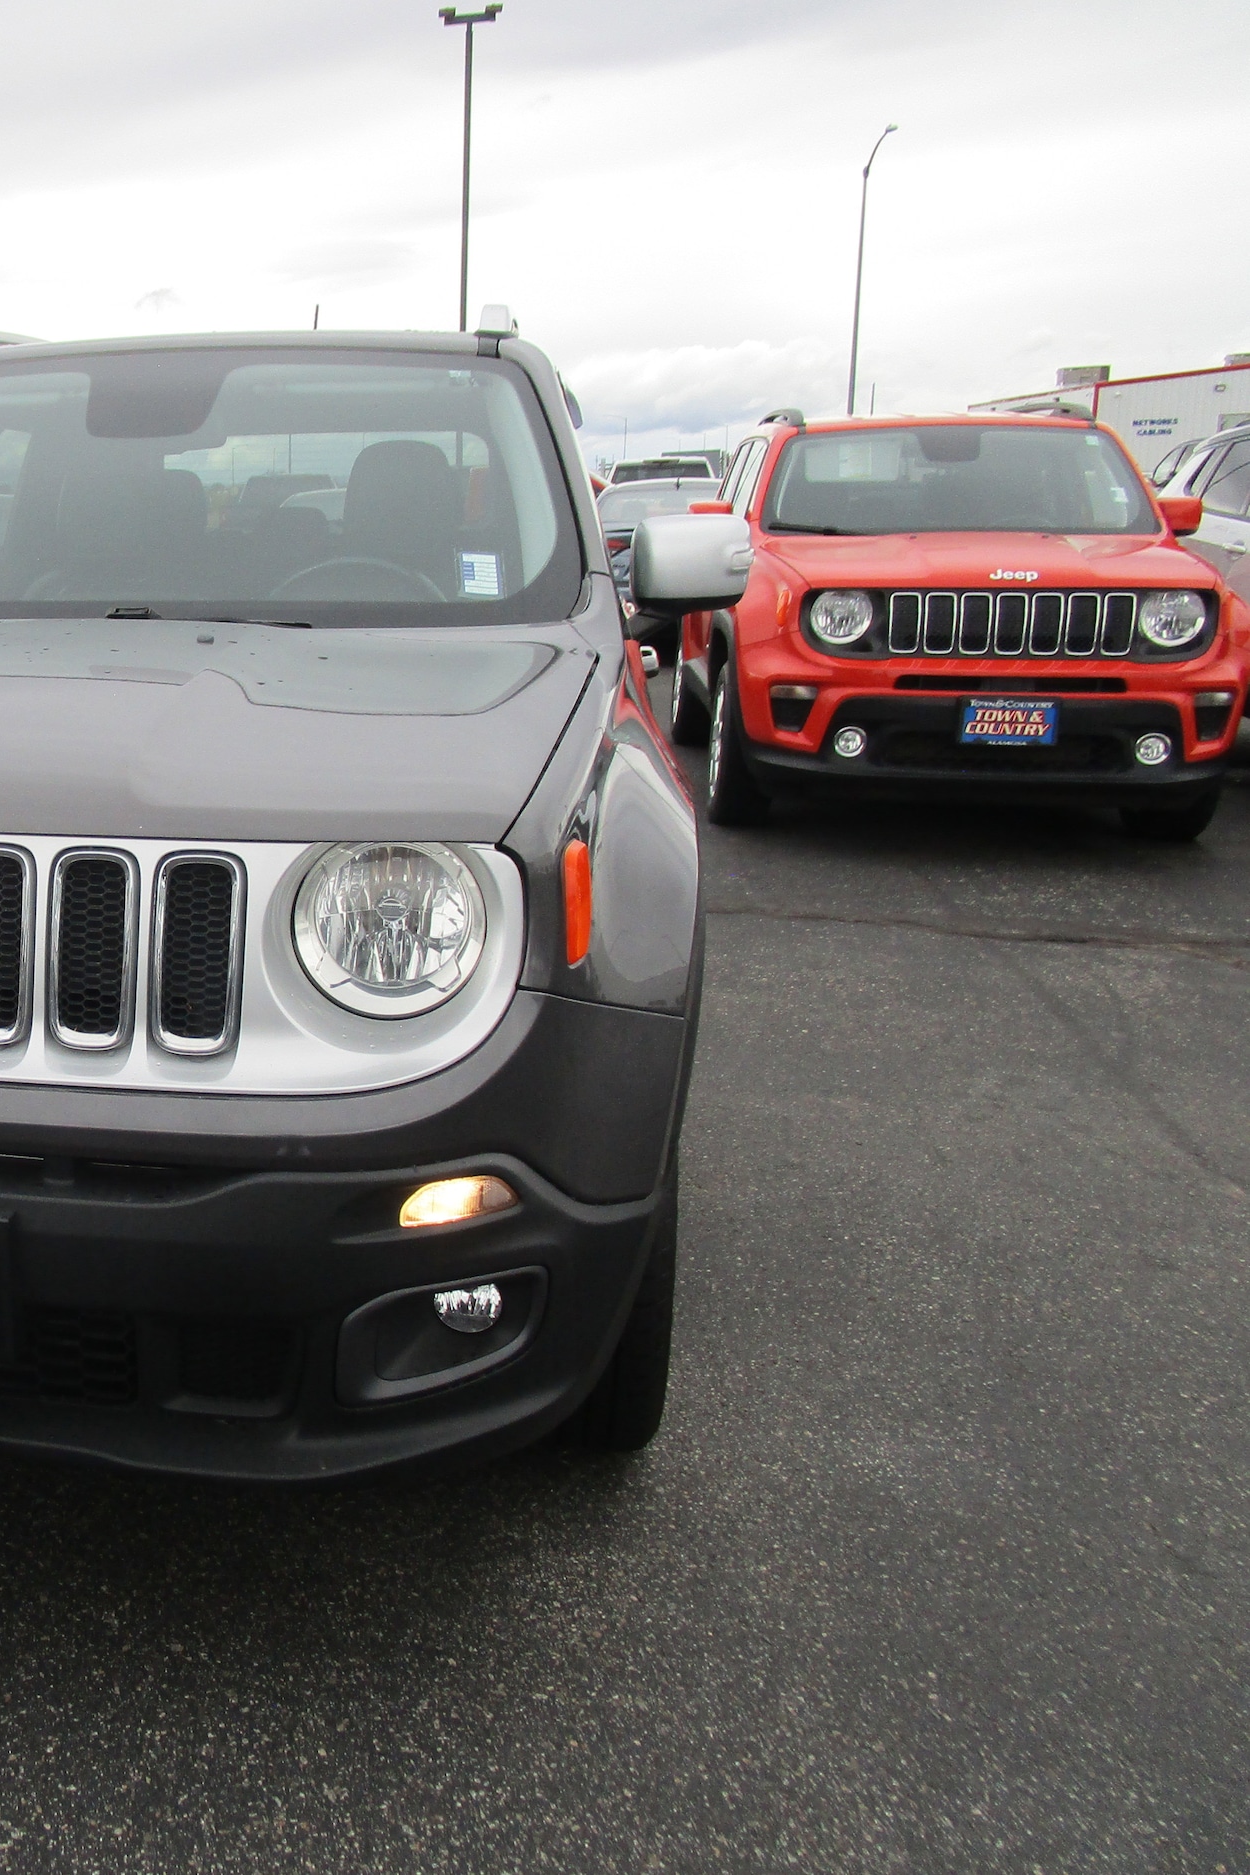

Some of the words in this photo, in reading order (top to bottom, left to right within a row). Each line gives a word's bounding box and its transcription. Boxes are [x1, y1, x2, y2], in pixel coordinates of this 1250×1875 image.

[989, 568, 1039, 583] Jeep
[975, 708, 1028, 723] TOWN
[1029, 709, 1044, 724] &
[964, 720, 1052, 737] COUNTRY
